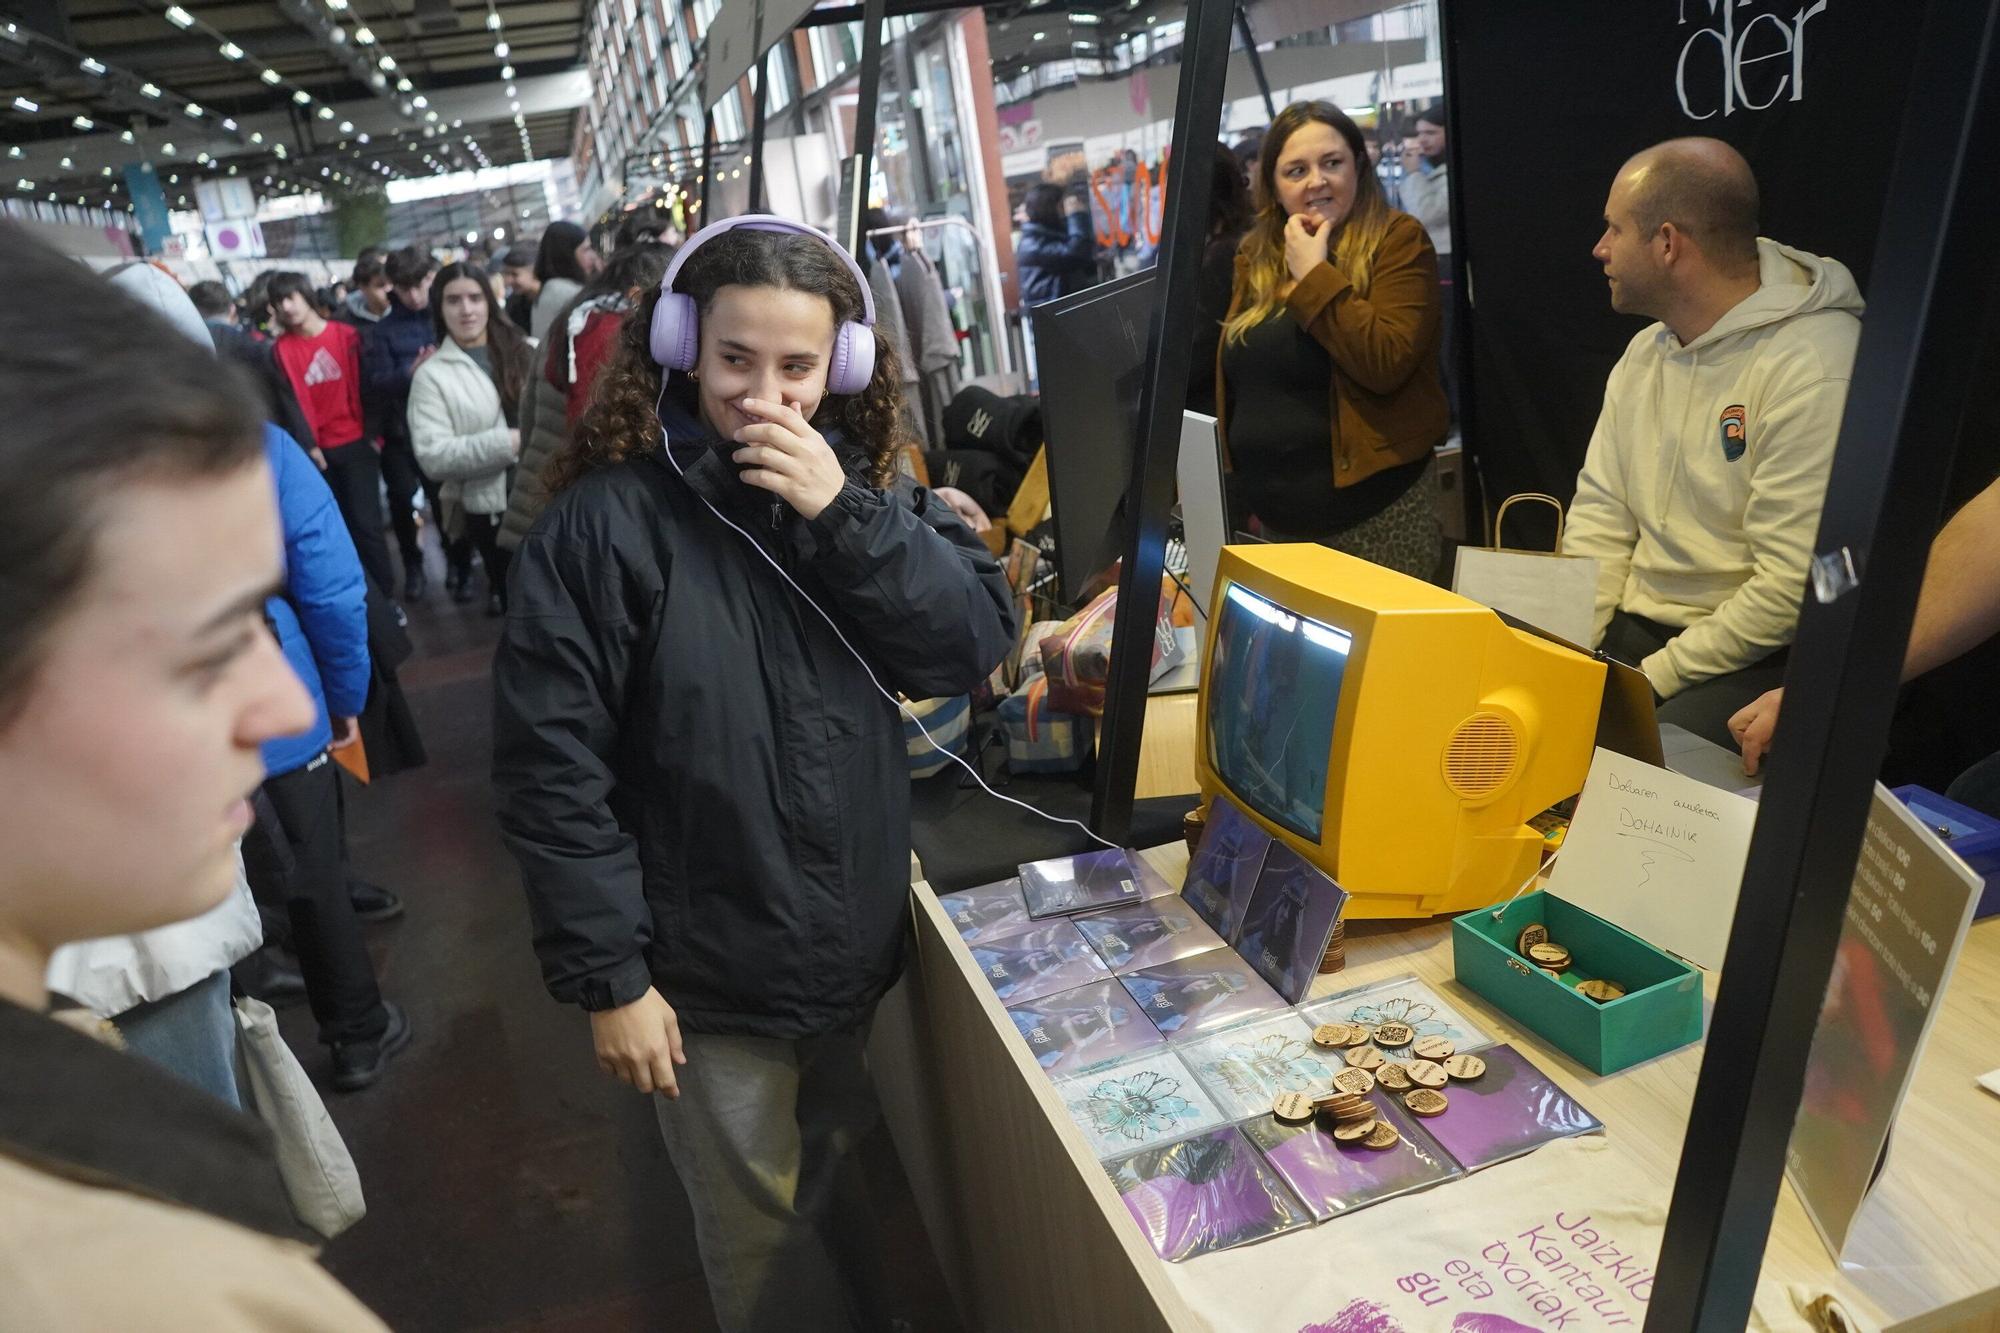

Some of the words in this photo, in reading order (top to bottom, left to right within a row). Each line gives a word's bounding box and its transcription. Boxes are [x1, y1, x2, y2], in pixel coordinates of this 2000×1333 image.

[1396, 1272, 1449, 1307] gu
[1444, 1258, 1494, 1300] eta
[1482, 1239, 1581, 1331] txoriak
